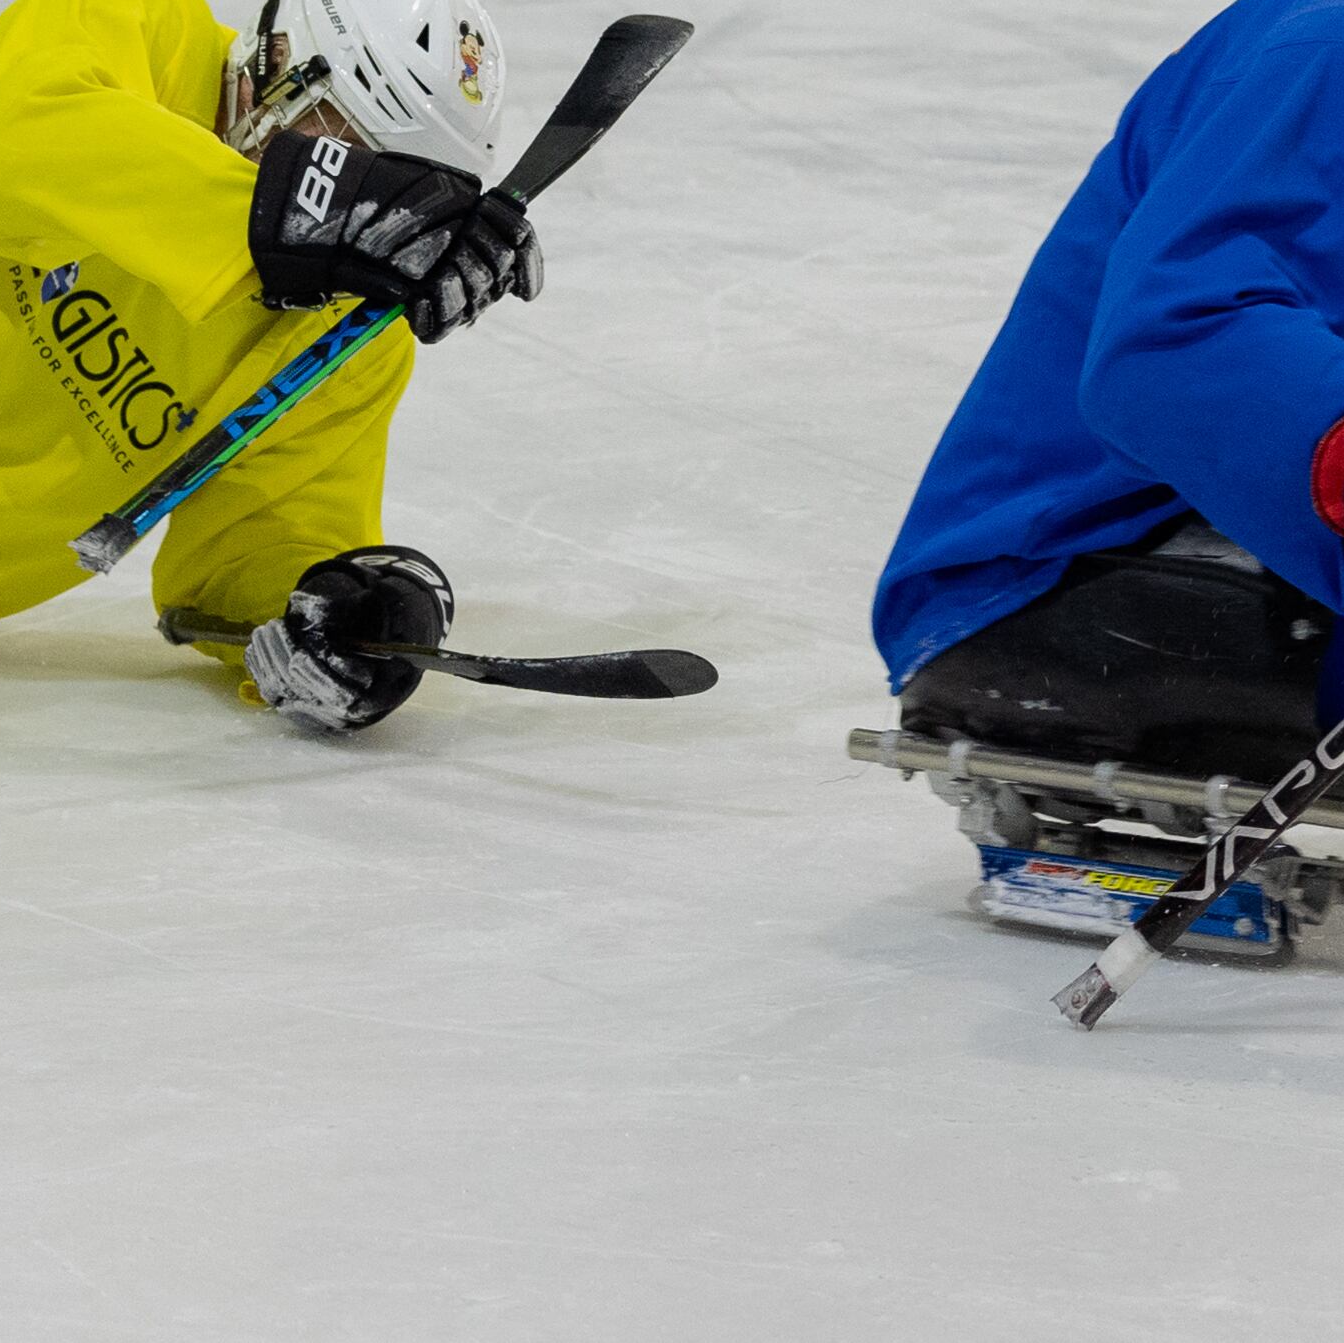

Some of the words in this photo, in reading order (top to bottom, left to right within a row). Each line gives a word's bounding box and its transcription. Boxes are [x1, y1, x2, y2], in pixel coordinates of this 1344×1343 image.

[258, 33, 268, 76] AUER
[31, 334, 62, 374] FOR
[60, 375, 135, 474] EXCELLENCE
[219, 308, 389, 442] NEX
